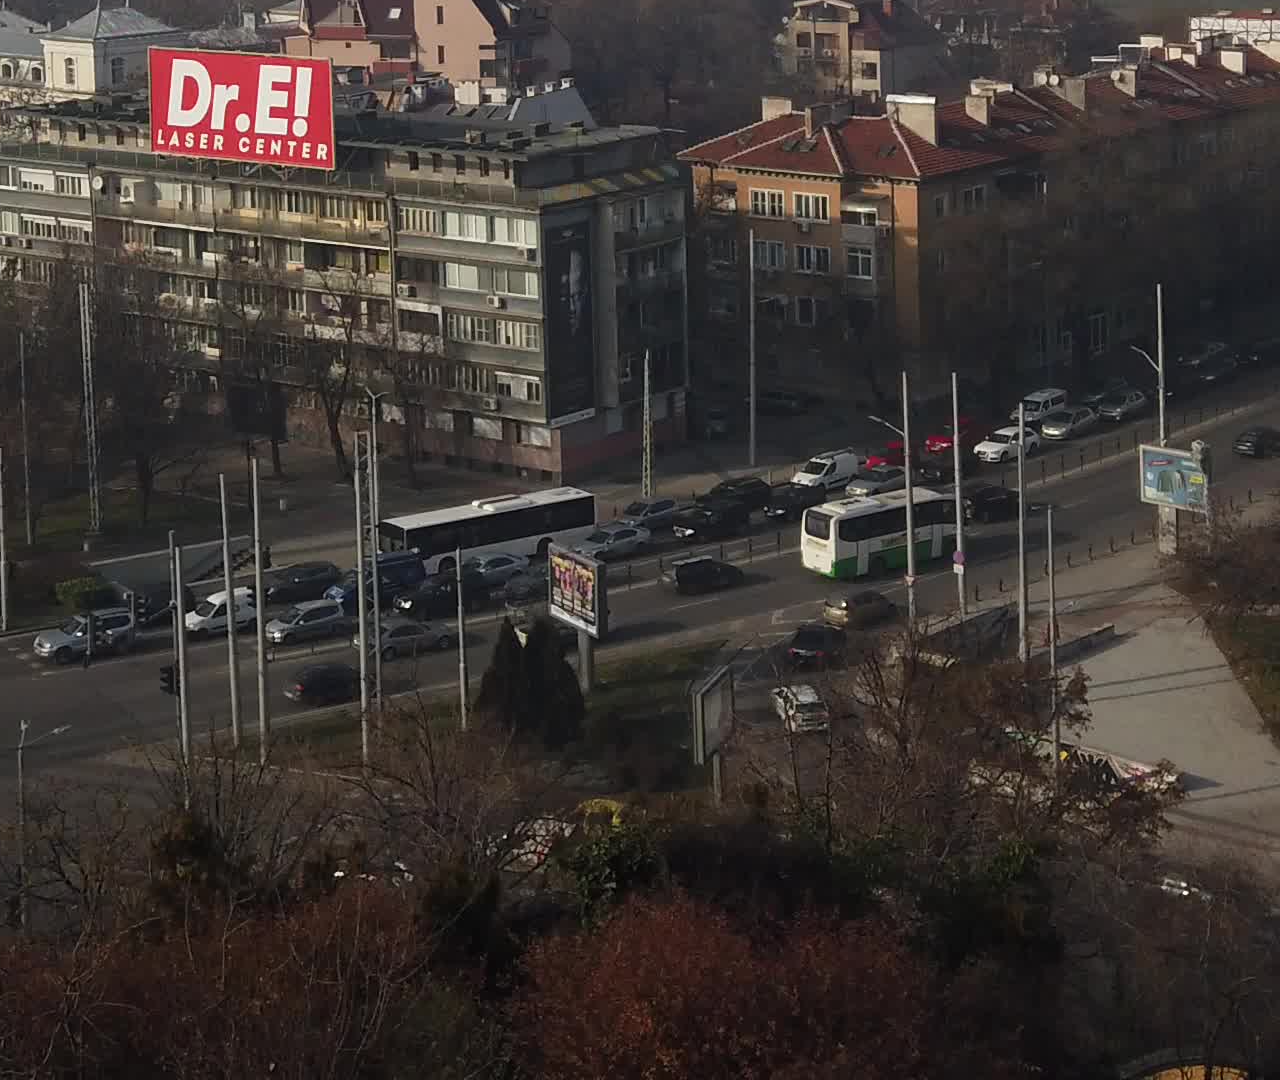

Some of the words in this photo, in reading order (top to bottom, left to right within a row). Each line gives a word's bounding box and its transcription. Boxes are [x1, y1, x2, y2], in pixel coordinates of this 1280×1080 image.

[167, 59, 313, 138] Dr.E!
[157, 128, 224, 151] LASER
[238, 136, 328, 160] CENTER
